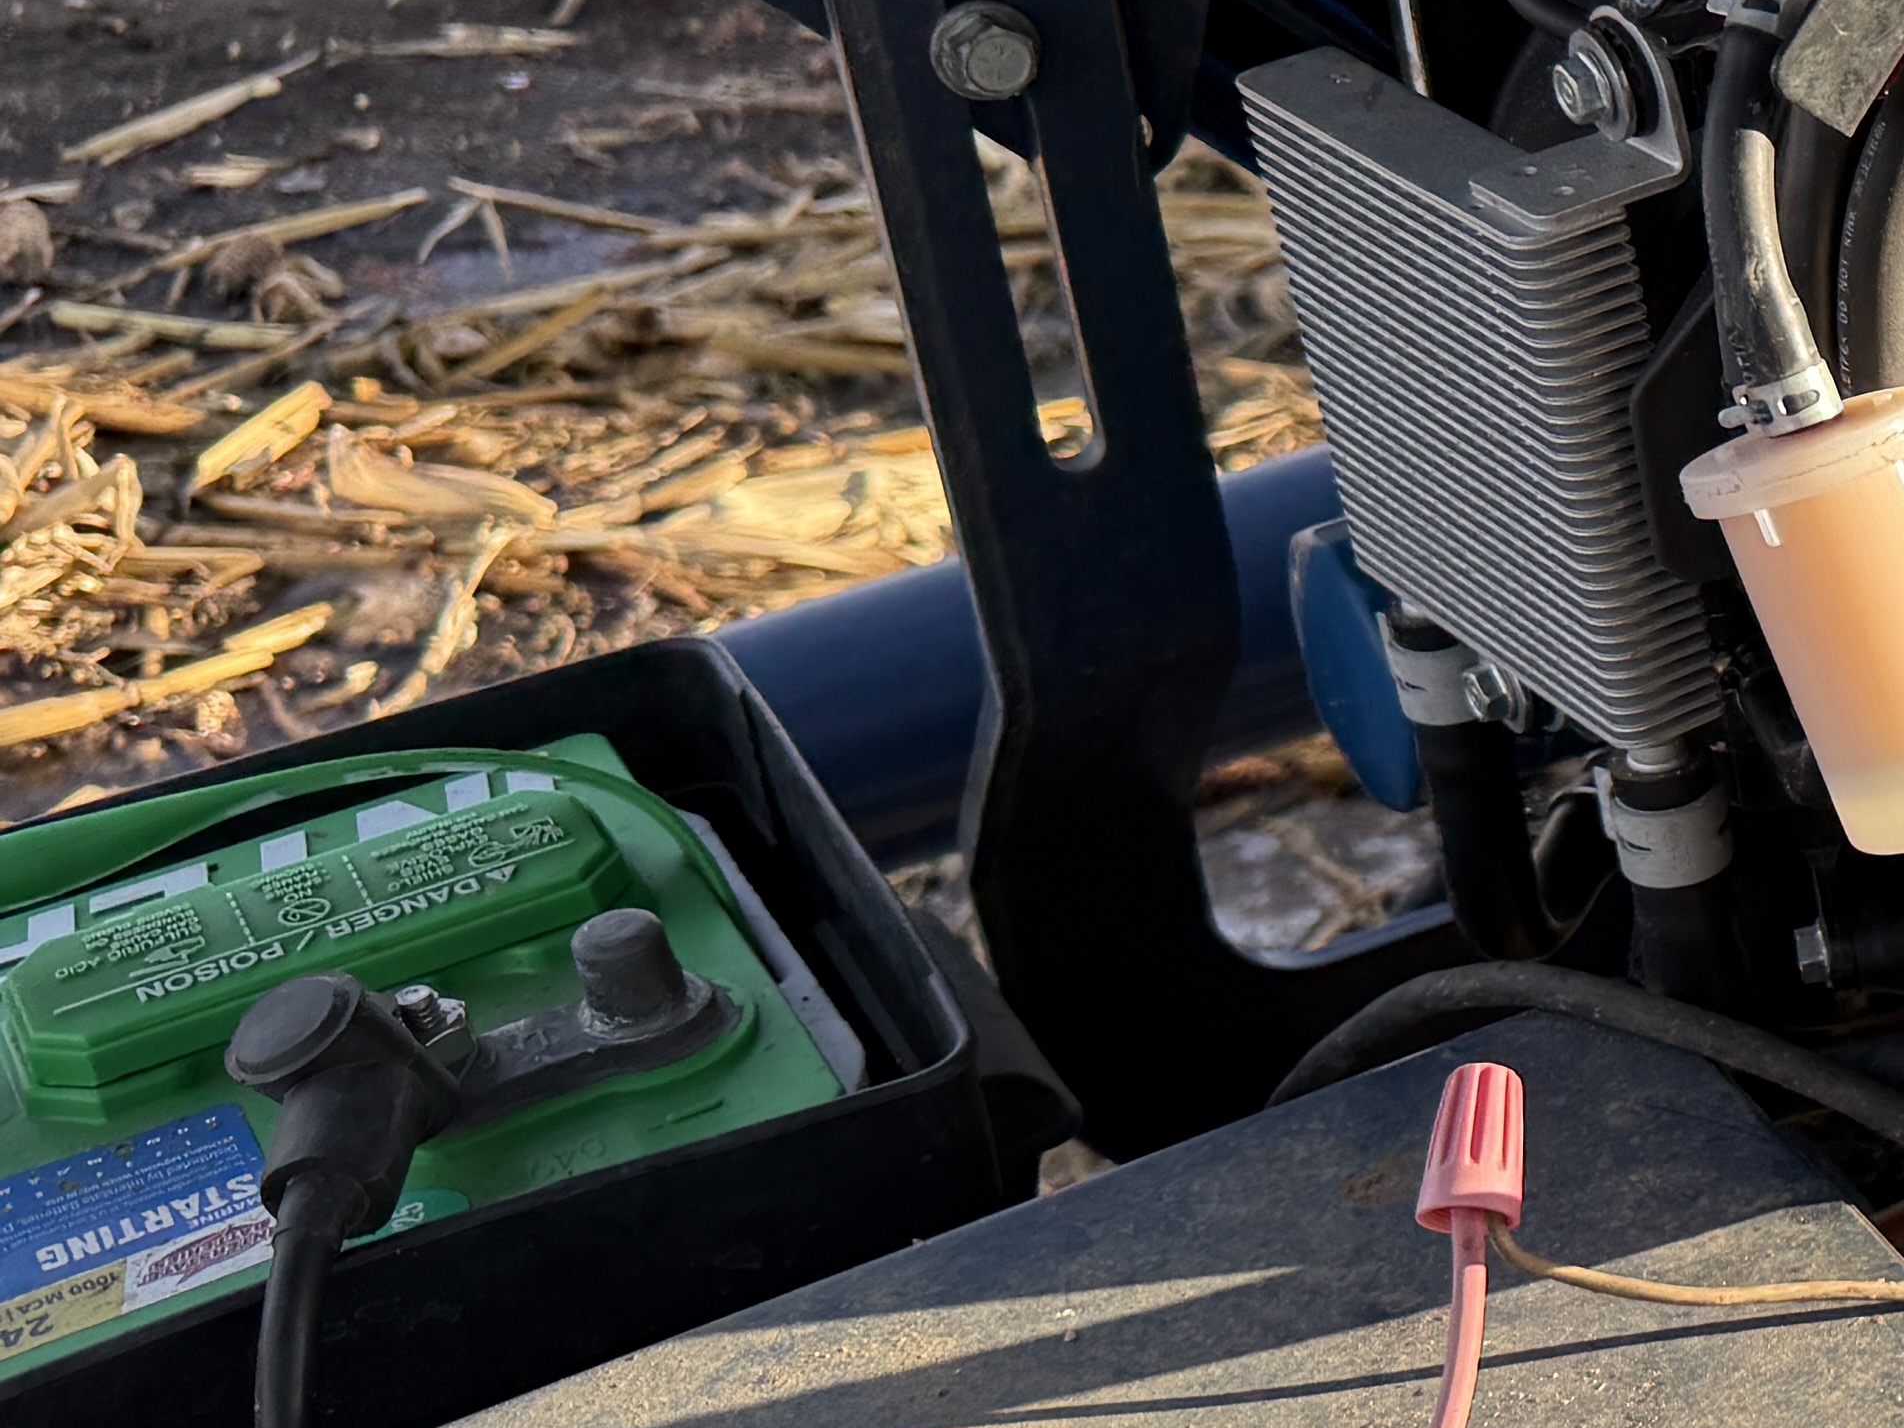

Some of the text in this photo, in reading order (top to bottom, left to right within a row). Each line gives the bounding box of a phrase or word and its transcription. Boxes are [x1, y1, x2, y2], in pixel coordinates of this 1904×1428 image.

[282, 887, 313, 905] NO
[325, 877, 481, 939] DANGER
[53, 922, 203, 979] SULFURIC ACID
[136, 942, 285, 1003] POISON
[145, 1168, 164, 1183] by
[36, 1173, 259, 1271] STARTING
[190, 1197, 263, 1228] MARINE
[16, 1272, 121, 1315] 1000 MCA
